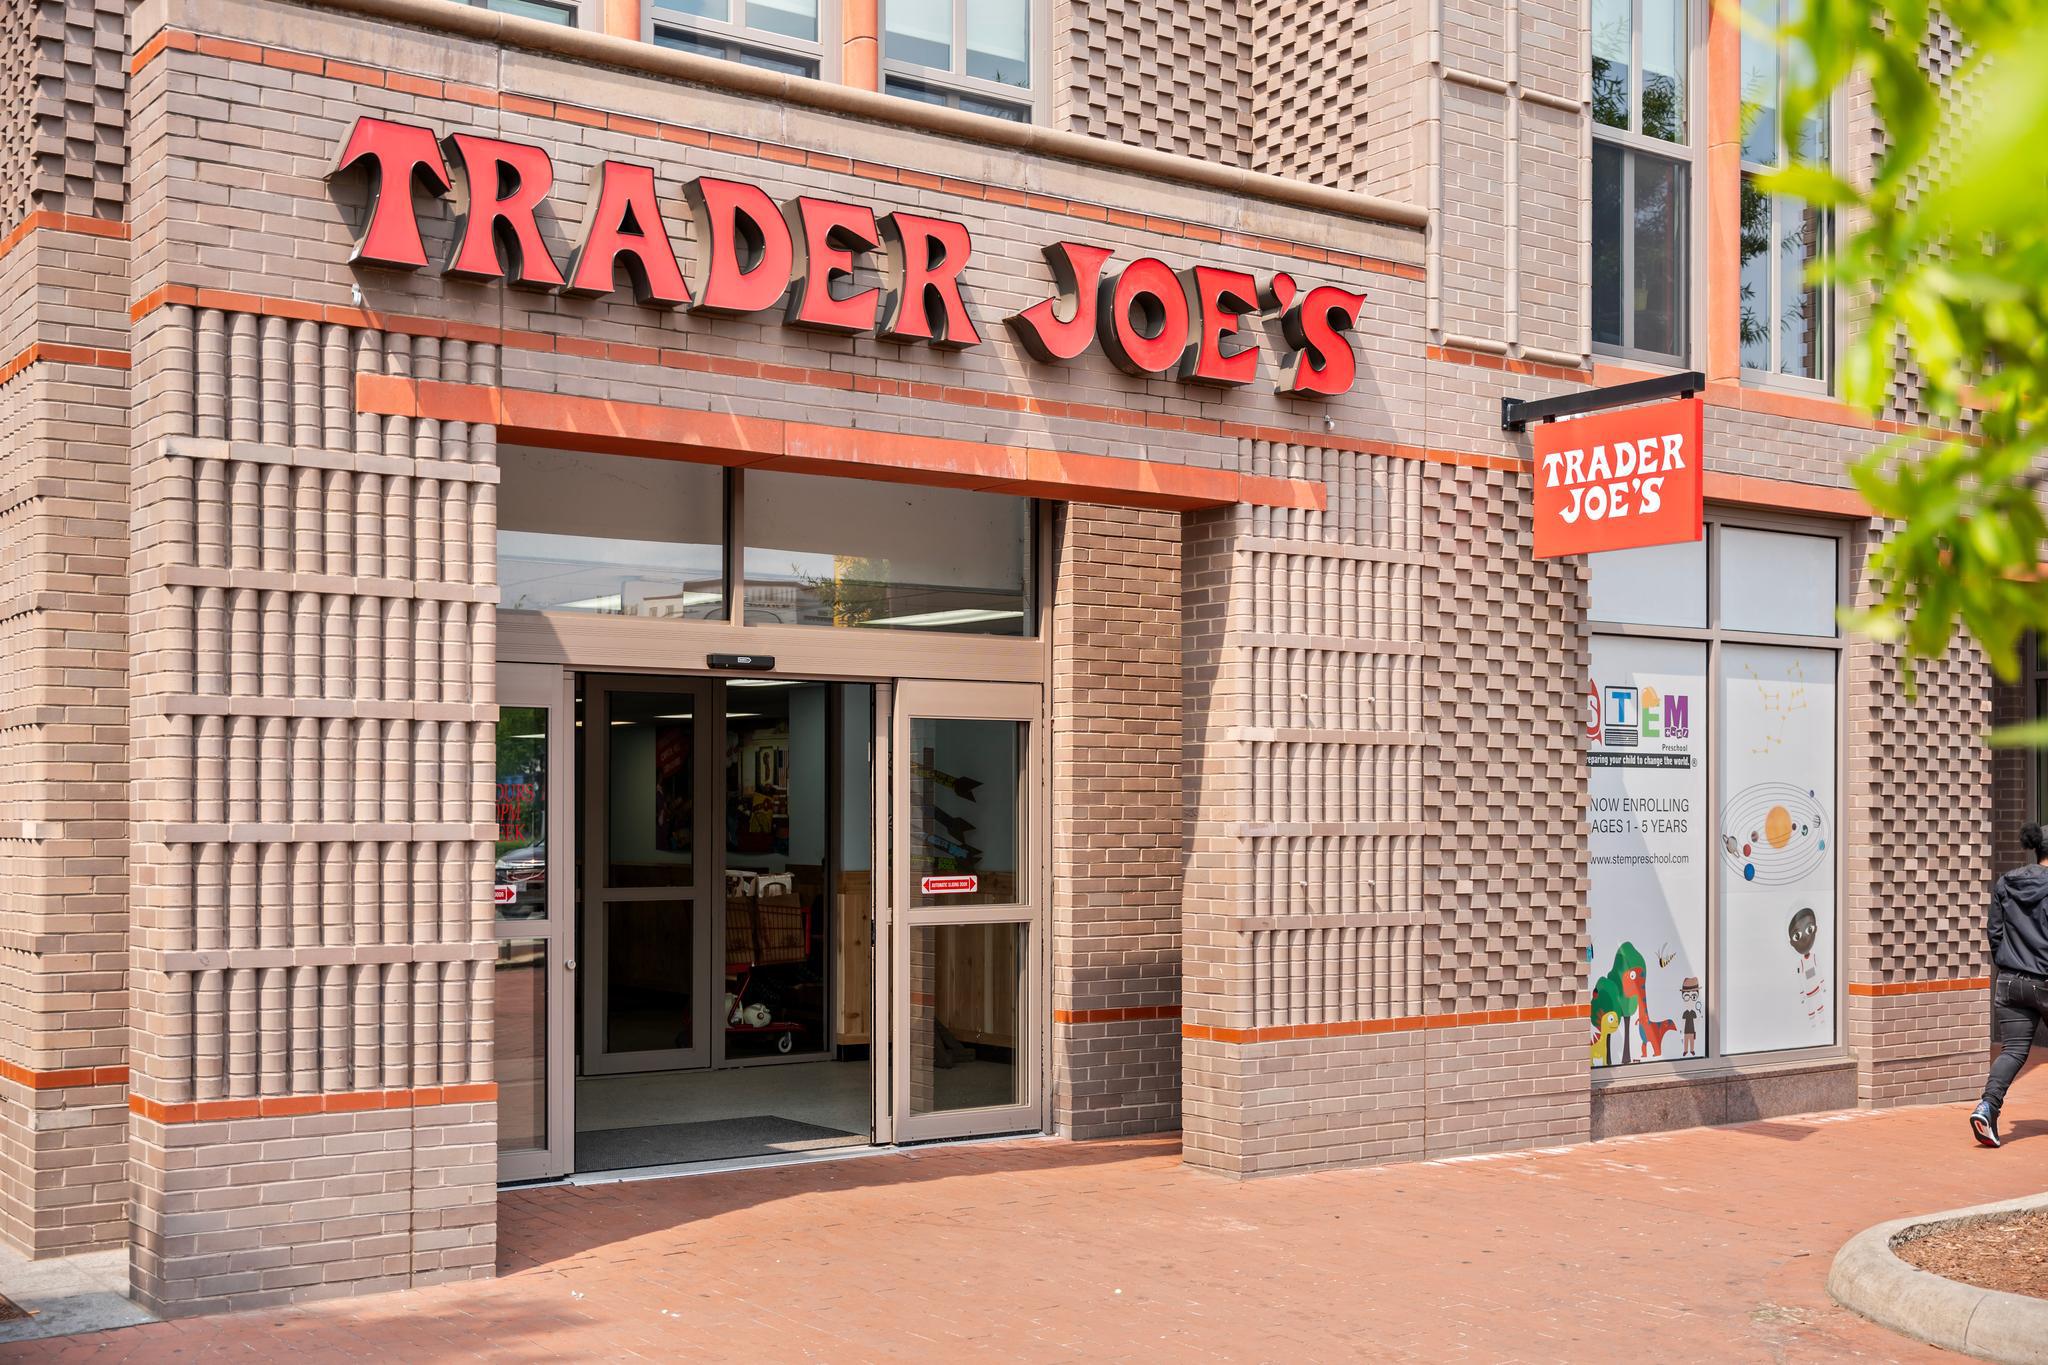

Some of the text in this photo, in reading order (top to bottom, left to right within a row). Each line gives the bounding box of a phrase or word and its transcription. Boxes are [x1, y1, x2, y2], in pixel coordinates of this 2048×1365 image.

[324, 115, 1368, 398] TRADER JOE'S
[1541, 433, 1686, 488] TRADER
[1558, 476, 1665, 524] JOE'S
[1661, 743, 1688, 752] Preschool
[1609, 756, 1622, 766] your
[1622, 755, 1636, 765] child
[1636, 755, 1643, 765] to
[1643, 755, 1663, 767] change
[1663, 755, 1673, 766] the
[1591, 797, 1689, 813] NOW ENROLLING
[1591, 818, 1624, 834] AGES
[1626, 819, 1631, 833] 1
[1641, 819, 1648, 834] 5
[1651, 819, 1688, 834] YEARS
[1591, 852, 1689, 867] www.stempreschool.com
